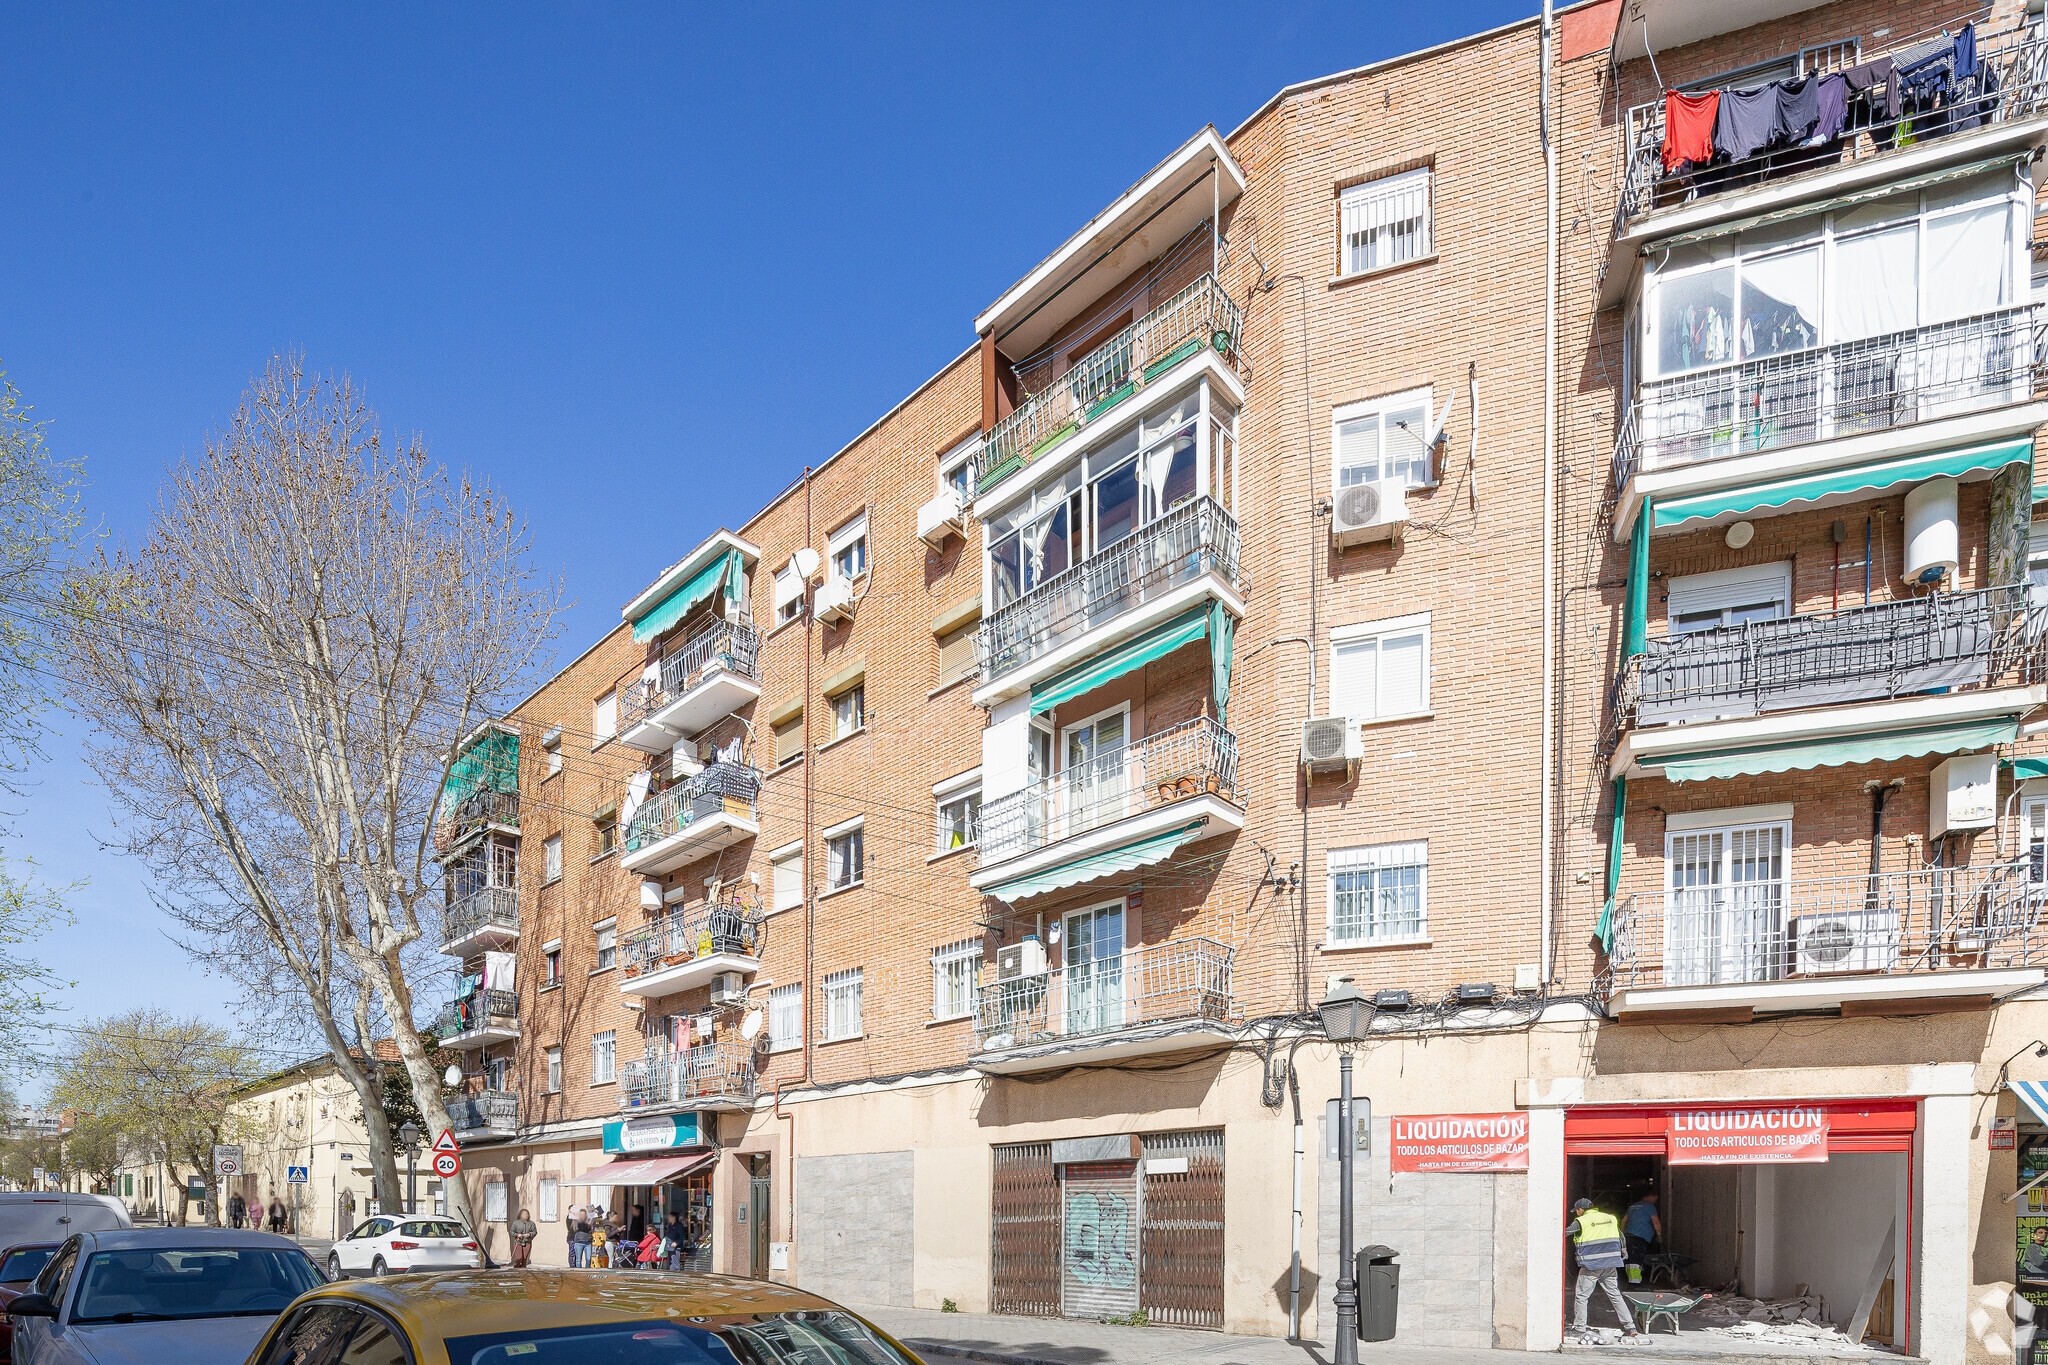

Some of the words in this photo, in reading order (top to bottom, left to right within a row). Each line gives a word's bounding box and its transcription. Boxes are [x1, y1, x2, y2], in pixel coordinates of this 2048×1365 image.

[1674, 1105, 1822, 1131] LIQUIDACIÓN
[1396, 1116, 1525, 1140] LIQUIDACIÓN
[1675, 1137, 1699, 1148] TODO
[1702, 1136, 1720, 1147] LOS
[1721, 1135, 1772, 1147] ARTICULOS
[1775, 1135, 1787, 1146] DE
[1789, 1134, 1822, 1145] BAZAR
[1397, 1146, 1418, 1156] TODO
[1420, 1145, 1437, 1155] LOS
[1437, 1144, 1482, 1155] ARTICULOS
[1485, 1144, 1495, 1154] DE
[1496, 1143, 1524, 1153] BAZAR
[439, 1160, 454, 1169] 20
